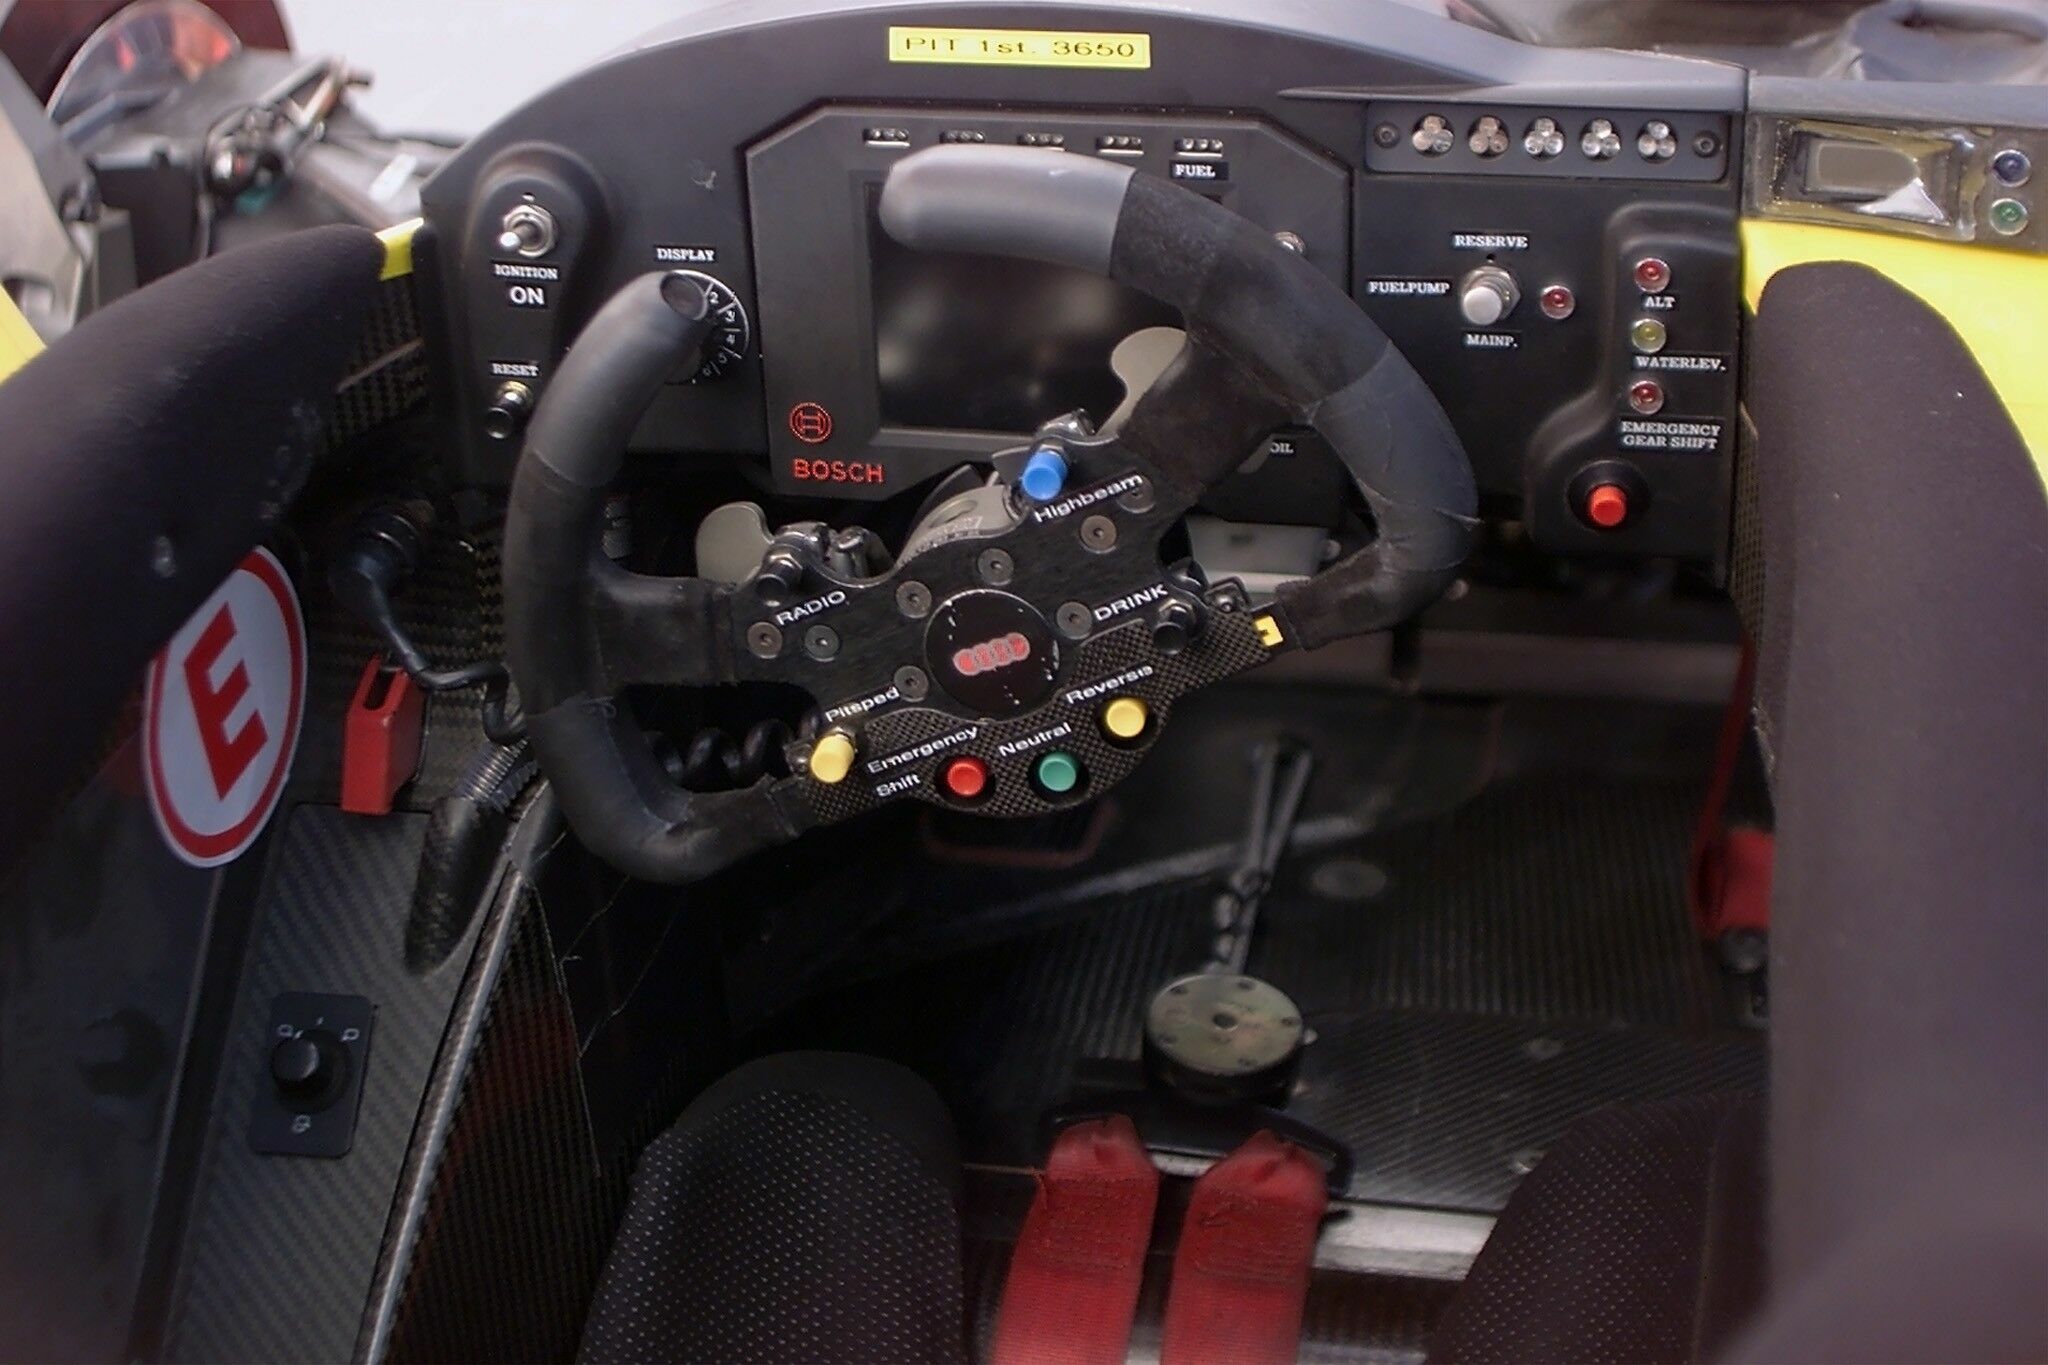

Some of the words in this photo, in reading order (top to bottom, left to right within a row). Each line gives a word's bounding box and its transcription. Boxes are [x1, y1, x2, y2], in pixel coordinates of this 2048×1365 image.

[905, 37, 960, 51] PIT
[981, 40, 1037, 54] 1st.
[1052, 40, 1136, 57] 3650
[1175, 163, 1216, 178] FUEL
[1454, 233, 1529, 248] RESERVE
[656, 247, 716, 261] DISPLAY
[494, 263, 559, 280] IGNITION
[509, 285, 546, 306] ON
[1368, 280, 1450, 295] FUELPUMP
[1644, 296, 1676, 309] ALT
[1465, 333, 1518, 348] MAINP.
[491, 363, 540, 377] RESET
[1634, 355, 1727, 372] WATERLEV.
[1620, 420, 1722, 437] EMERGENCY
[1622, 434, 1667, 447] GEAR
[1669, 435, 1718, 450] SHIFT
[793, 458, 885, 484] BOSCH
[1033, 473, 1144, 523] Highbeam
[774, 589, 847, 626] RADIO
[1093, 583, 1169, 622] DRINK
[182, 599, 270, 802] E
[997, 720, 1072, 757] Neutral
[866, 725, 979, 774] Emergency
[874, 772, 922, 798] Shift
